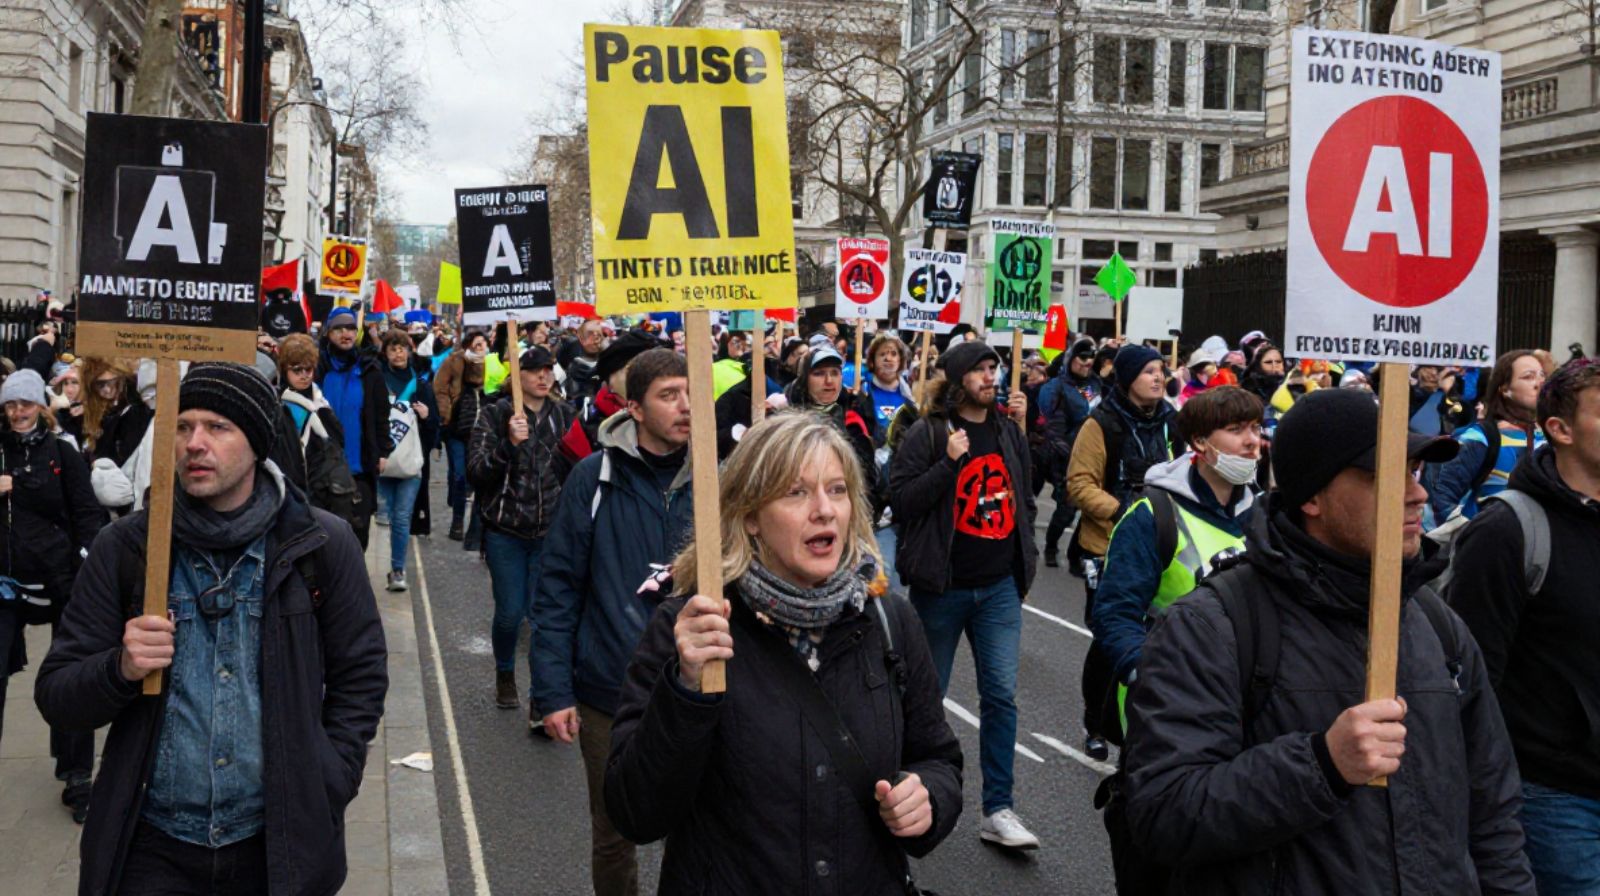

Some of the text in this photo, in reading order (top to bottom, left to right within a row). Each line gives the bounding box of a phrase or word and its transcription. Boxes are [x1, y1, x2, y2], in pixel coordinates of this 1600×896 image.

[594, 31, 767, 84] Pause
[616, 104, 760, 240] AI
[1342, 144, 1454, 259] AI
